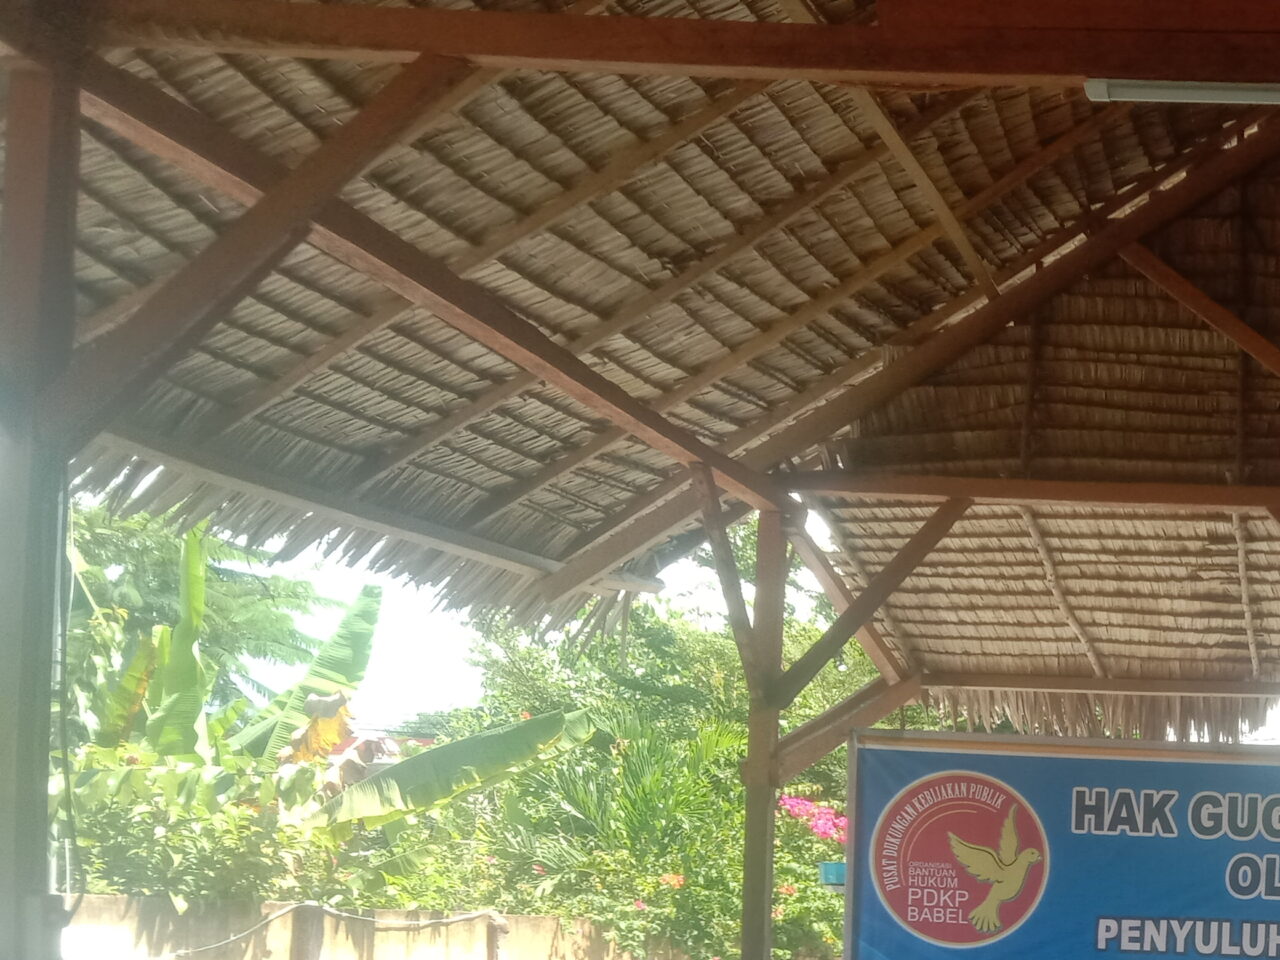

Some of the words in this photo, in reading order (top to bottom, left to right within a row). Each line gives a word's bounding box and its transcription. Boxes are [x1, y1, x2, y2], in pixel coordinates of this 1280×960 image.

[912, 782, 967, 813] KEBIJAKAN
[969, 783, 1006, 809] PUBLIK
[1072, 787, 1178, 838] HAK
[883, 803, 918, 857] DUKUNGAN
[882, 859, 901, 892] PUSAT
[908, 867, 956, 877] BANTUAN
[908, 876, 959, 888] HUKUM
[908, 888, 969, 907] PDKP
[907, 906, 969, 924] BABEL
